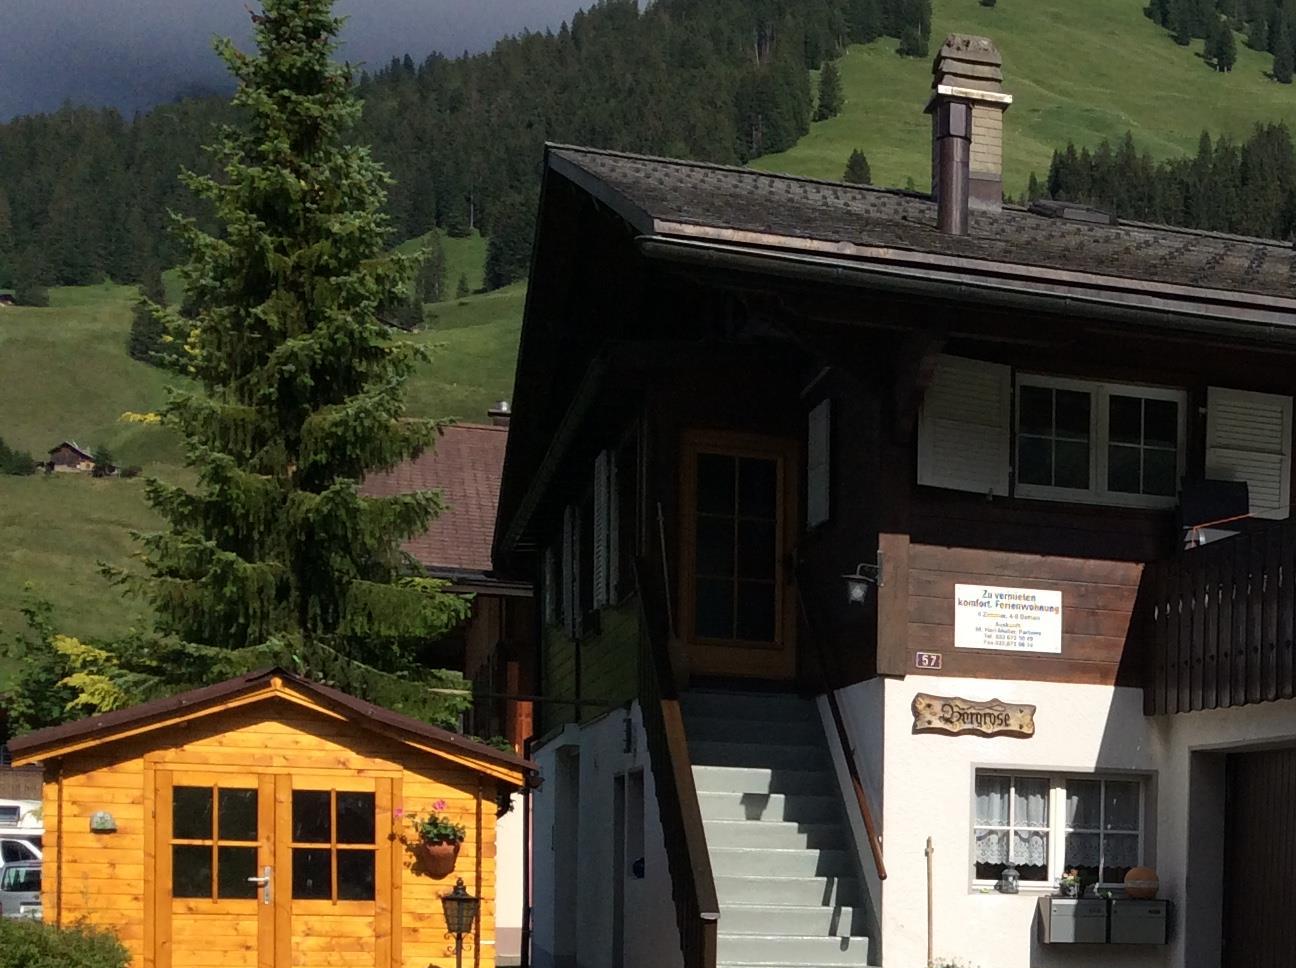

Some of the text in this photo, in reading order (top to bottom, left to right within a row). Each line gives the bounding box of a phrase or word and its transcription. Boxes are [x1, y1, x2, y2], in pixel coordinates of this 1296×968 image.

[982, 589, 1036, 602] Zu vermieten
[995, 600, 1060, 615] Ferienwohnung
[921, 654, 937, 666] 57
